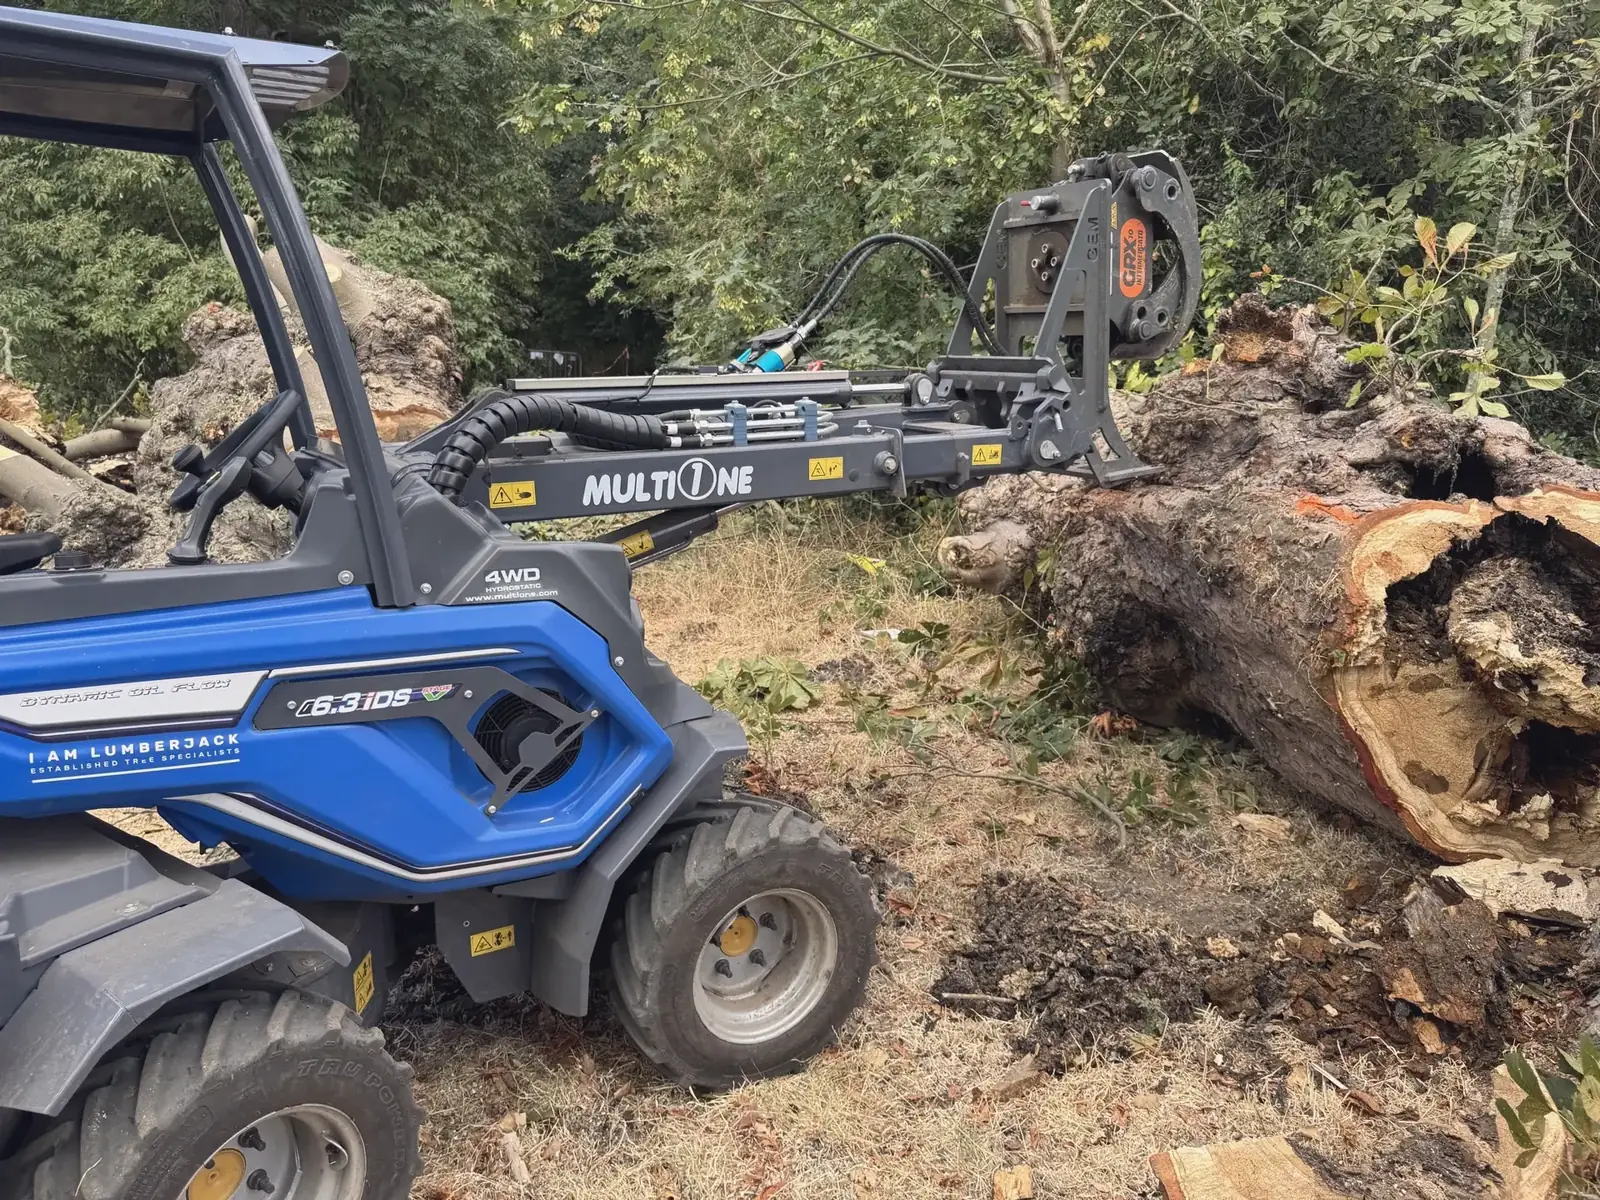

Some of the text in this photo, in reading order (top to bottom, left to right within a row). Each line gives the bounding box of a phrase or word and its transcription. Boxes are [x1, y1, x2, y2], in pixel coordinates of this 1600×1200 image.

[1087, 217, 1099, 262] GEM
[1122, 237, 1137, 287] GRX
[484, 567, 541, 584] 4WD
[485, 583, 541, 593] HYDROSTATIC
[20, 679, 231, 707] DYNAMIC OIL FLOW
[29, 733, 239, 763] I AM LUMBERJACK
[30, 748, 241, 775] ESTABLISHED TREE SPECIALISTS
